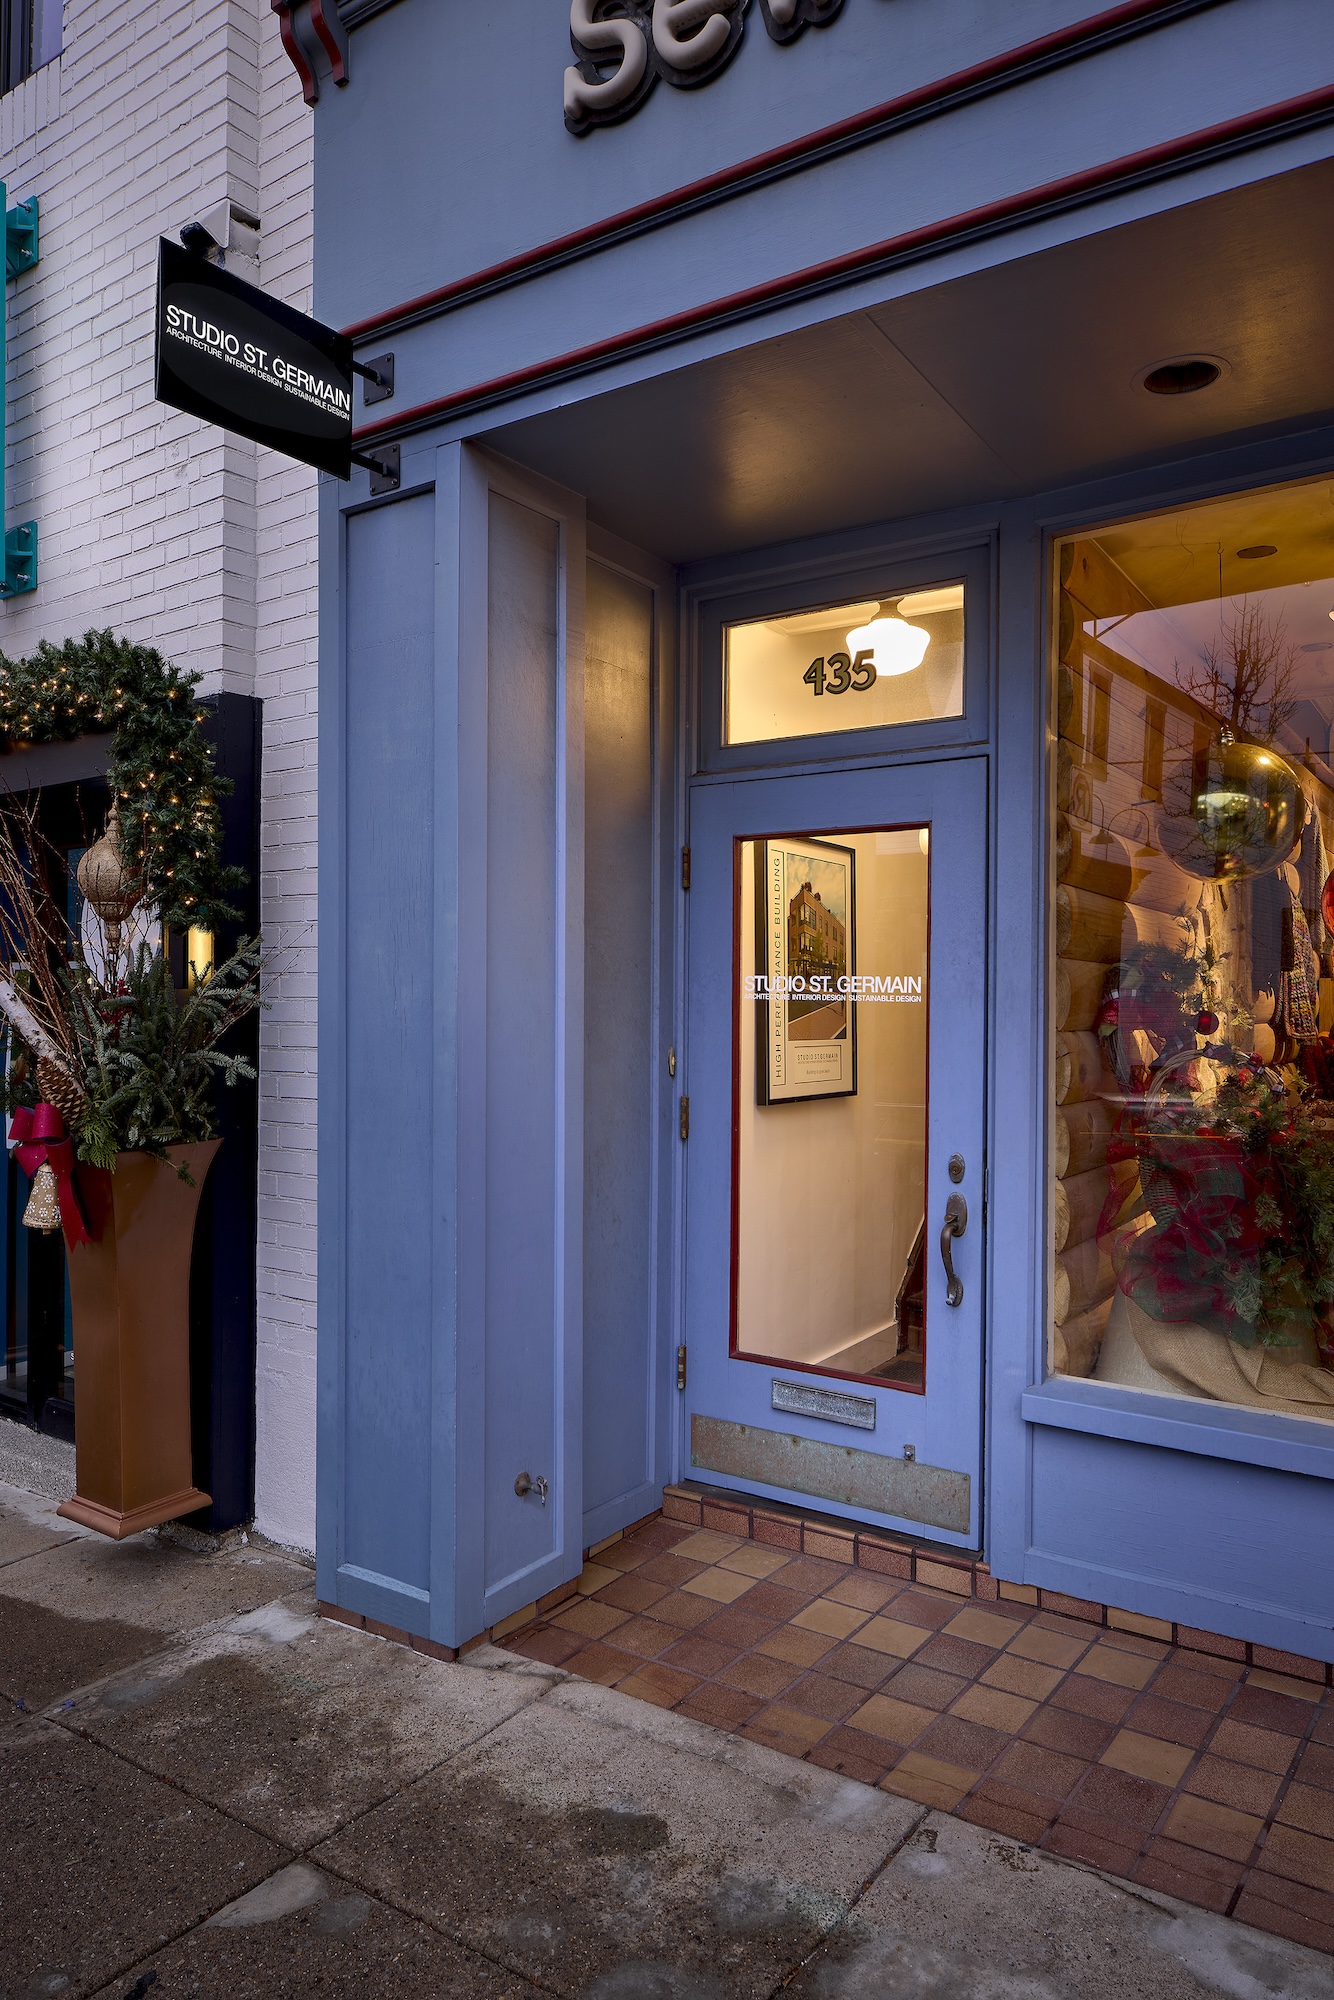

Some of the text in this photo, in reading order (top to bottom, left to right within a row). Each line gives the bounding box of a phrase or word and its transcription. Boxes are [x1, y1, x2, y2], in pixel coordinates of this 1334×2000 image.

[563, 0, 834, 120] Se
[166, 304, 351, 412] STUDIO ST. GERMAIN
[166, 326, 350, 421] ARCHITECTURE INTERIOR DESIGN SUSTAINABLE DESIGN
[802, 648, 877, 697] 435
[773, 857, 781, 925] BUILDING
[743, 993, 922, 1003] ARCHITECTURE INTERIOR DESIGN SUSTAINABLE DESIGN
[744, 975, 922, 994] STUDIO ST. GERMAIN
[774, 1044, 782, 1078] HIGH
